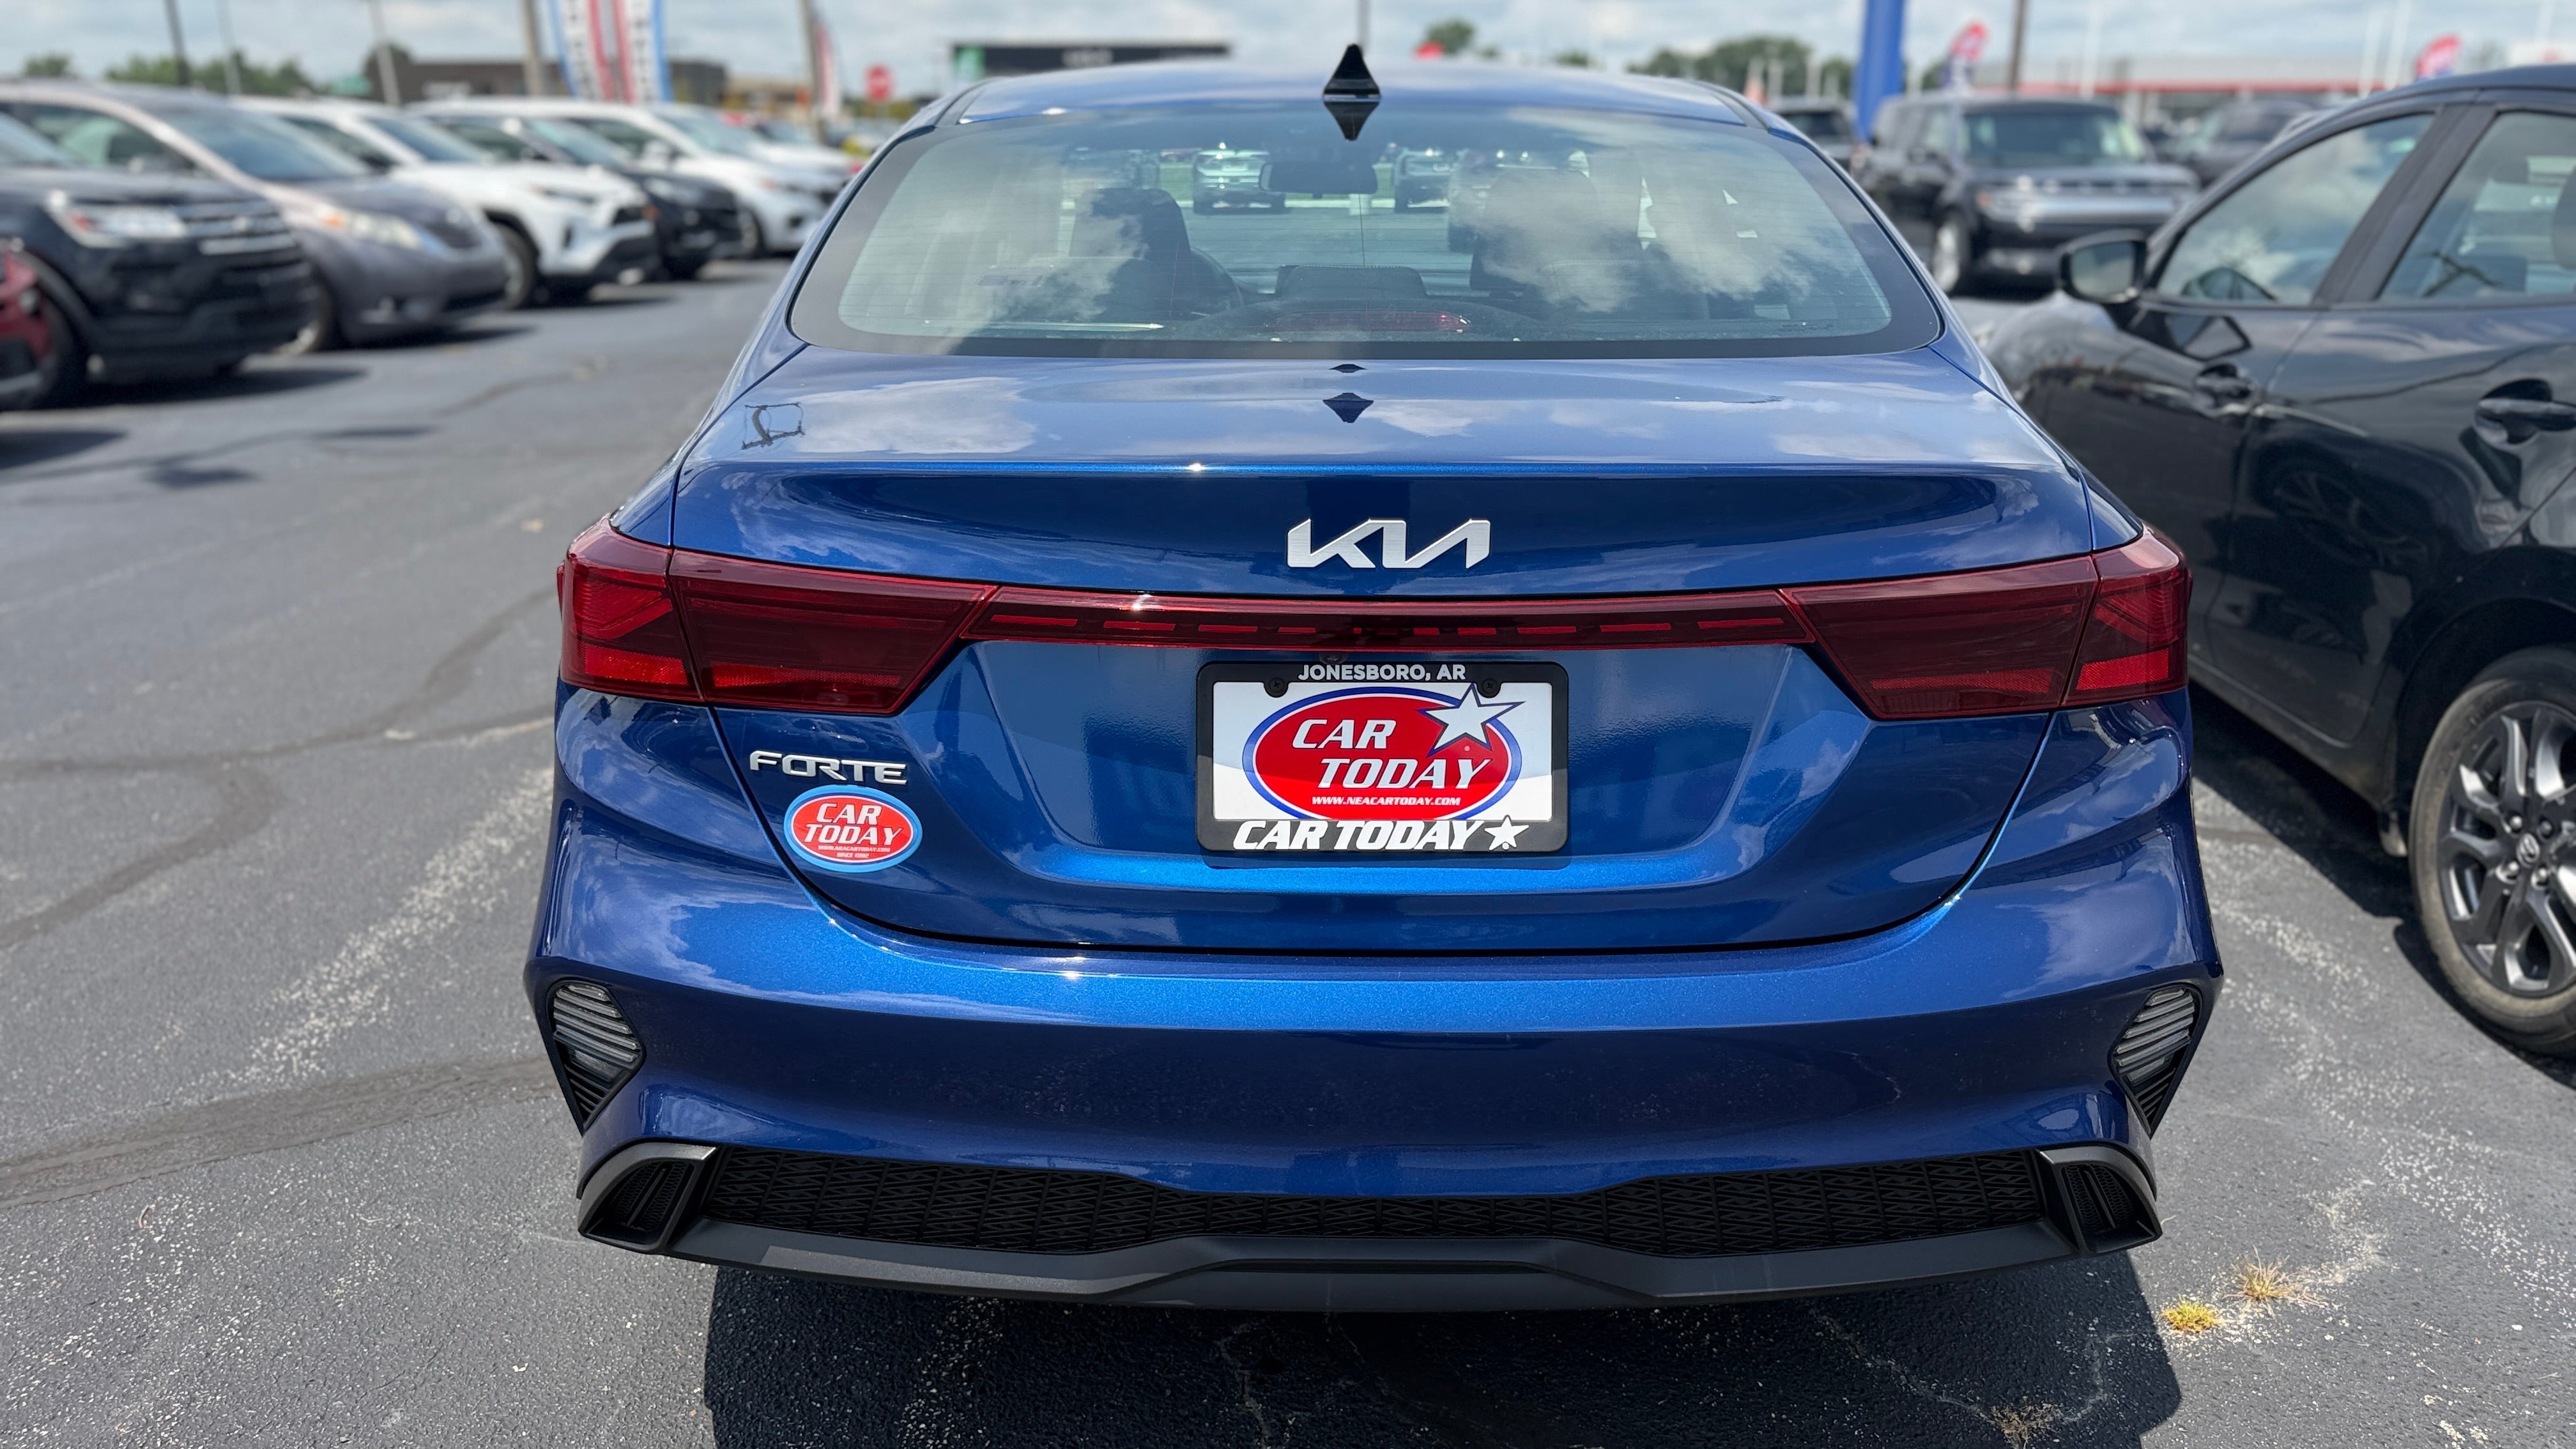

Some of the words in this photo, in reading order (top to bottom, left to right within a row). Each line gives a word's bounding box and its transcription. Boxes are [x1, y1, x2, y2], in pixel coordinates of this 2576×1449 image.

[1286, 518, 1491, 569] KIA
[1298, 664, 1431, 682] JONESBORO,
[1436, 664, 1466, 680] AR
[1292, 719, 1397, 749] CAR
[749, 750, 907, 785] FORTE
[1317, 758, 1492, 789] TODAY
[816, 802, 882, 825] CAR
[1312, 796, 1461, 806] WWW.NEACARTODAY.COM
[804, 824, 902, 846] TODAY
[1232, 820, 1329, 850] CAR
[1333, 820, 1485, 850] TODAY
